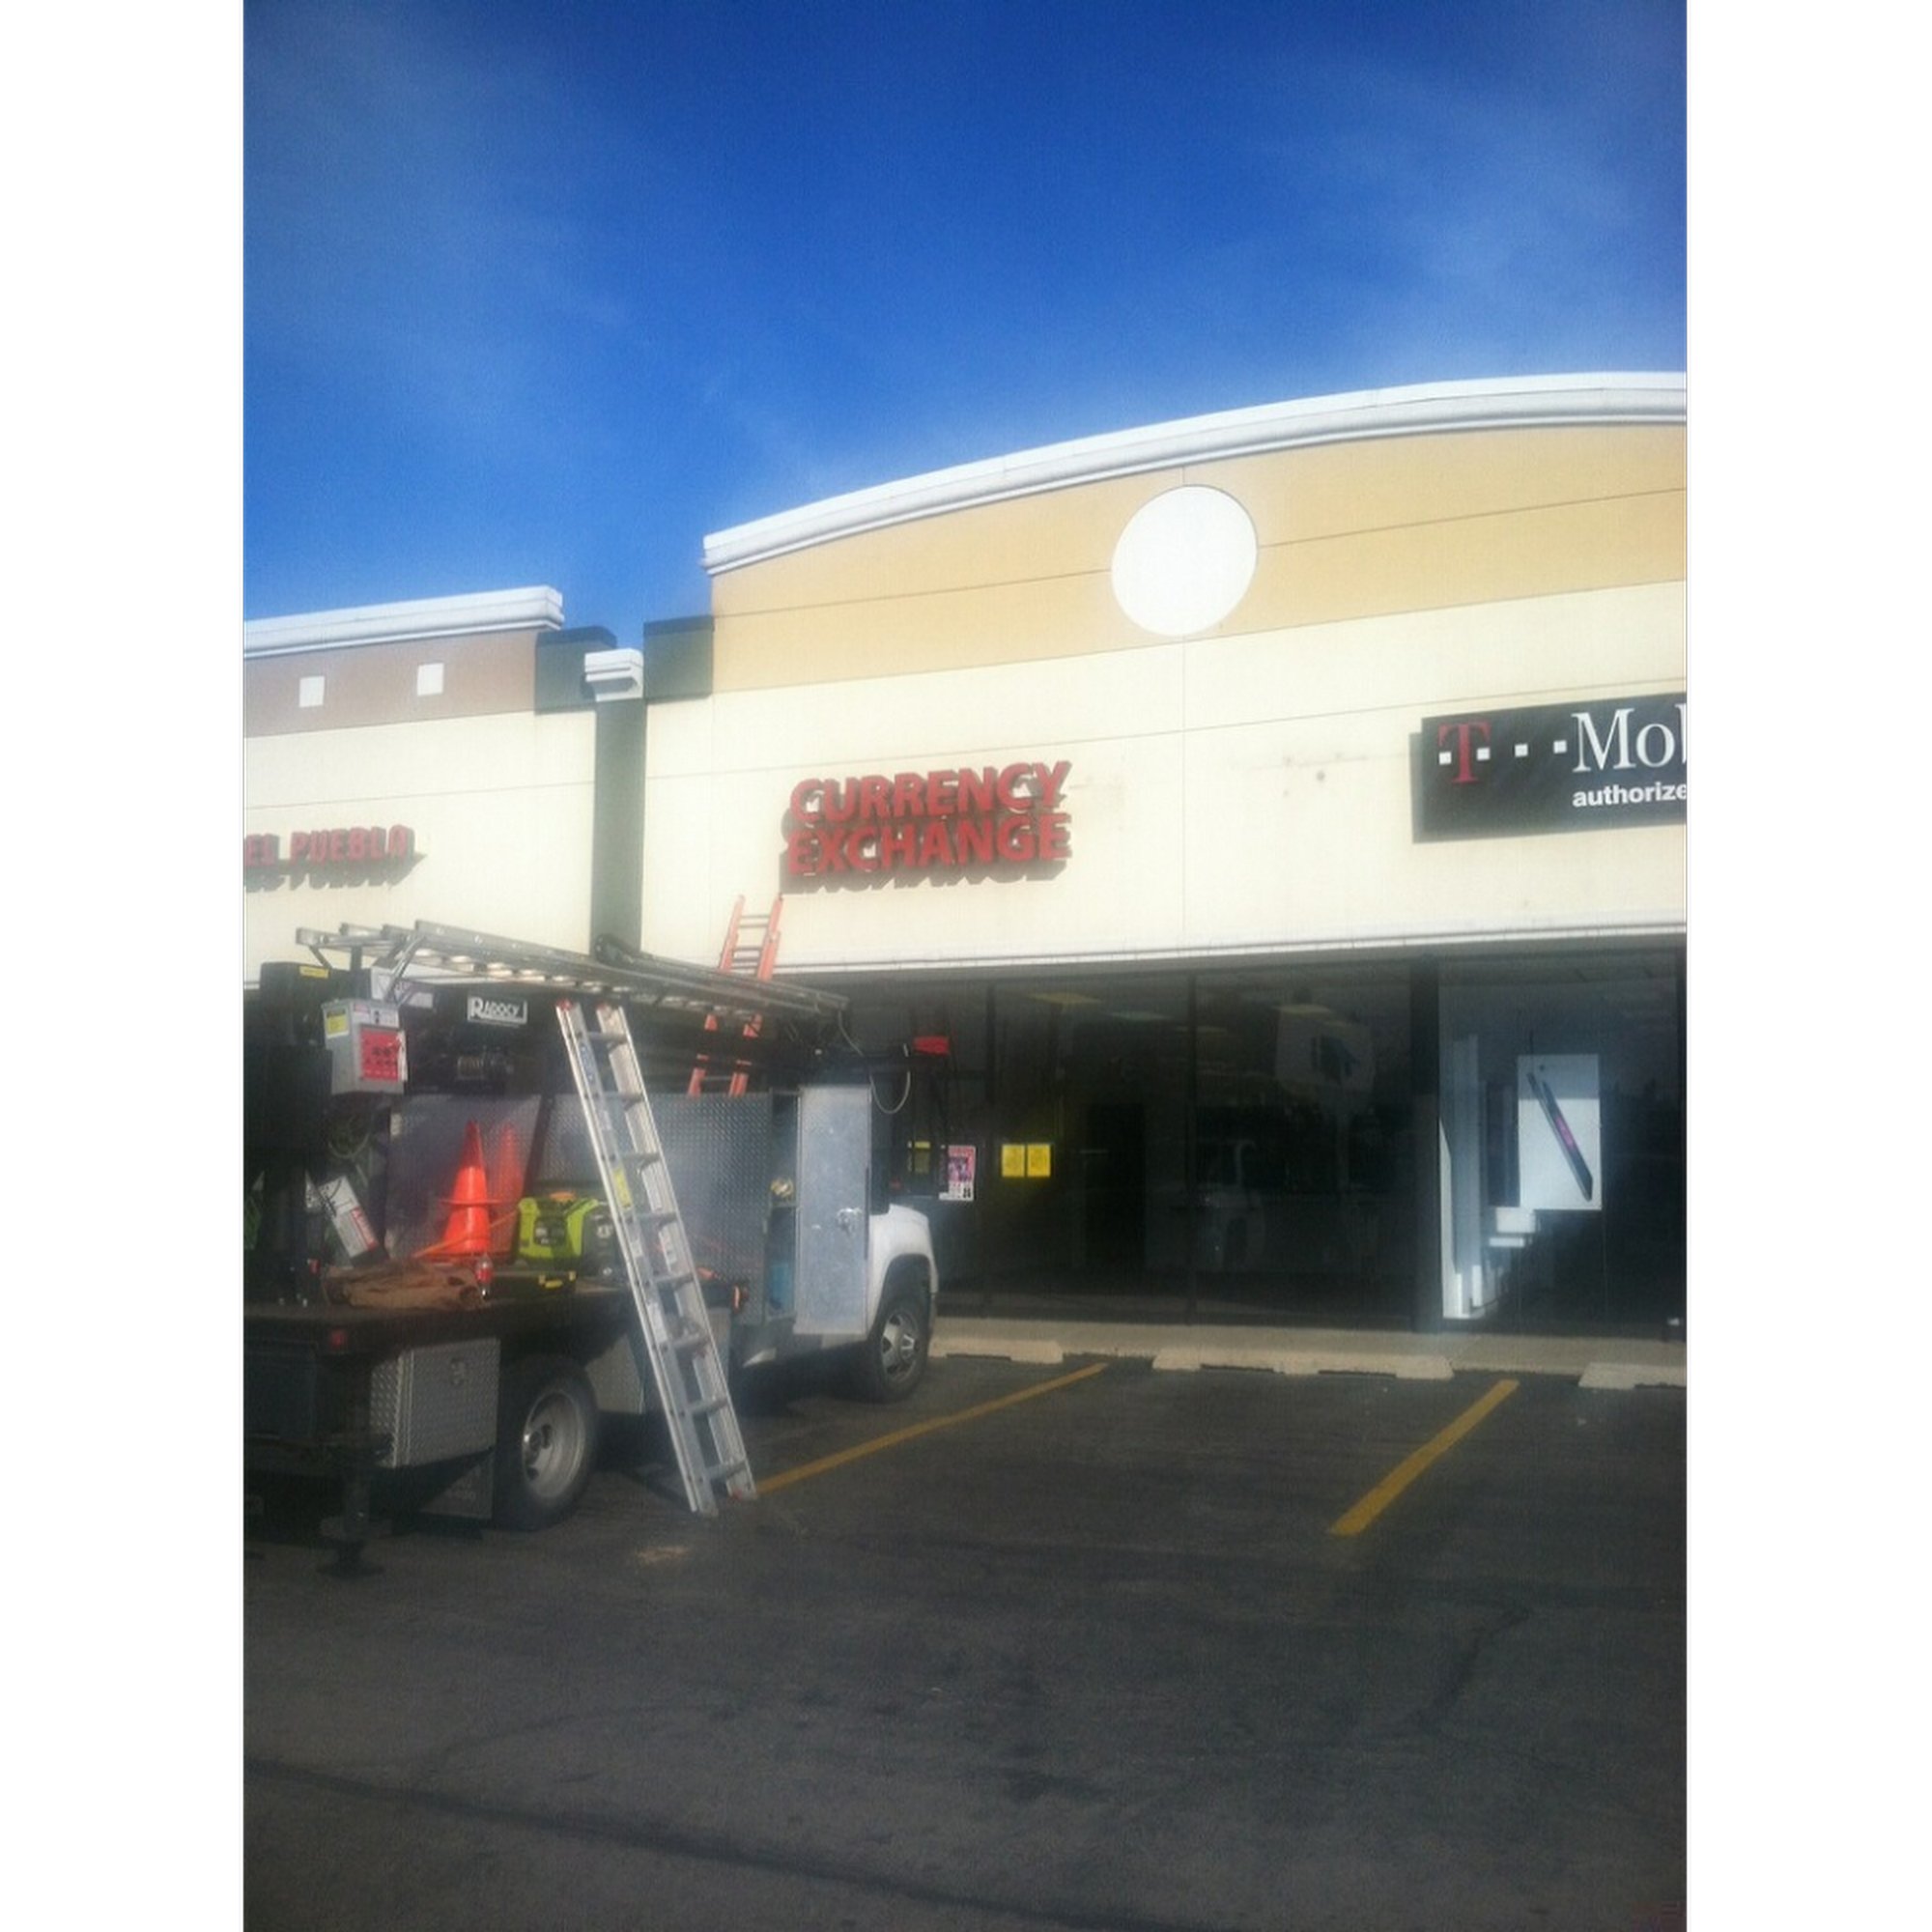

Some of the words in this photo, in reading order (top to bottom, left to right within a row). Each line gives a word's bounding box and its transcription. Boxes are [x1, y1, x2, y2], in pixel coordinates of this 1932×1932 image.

[790, 760, 1071, 824] CURRENCY
[244, 832, 278, 868] EL
[289, 824, 410, 867] PUEBLO
[787, 812, 1071, 876] EXCHANGE
